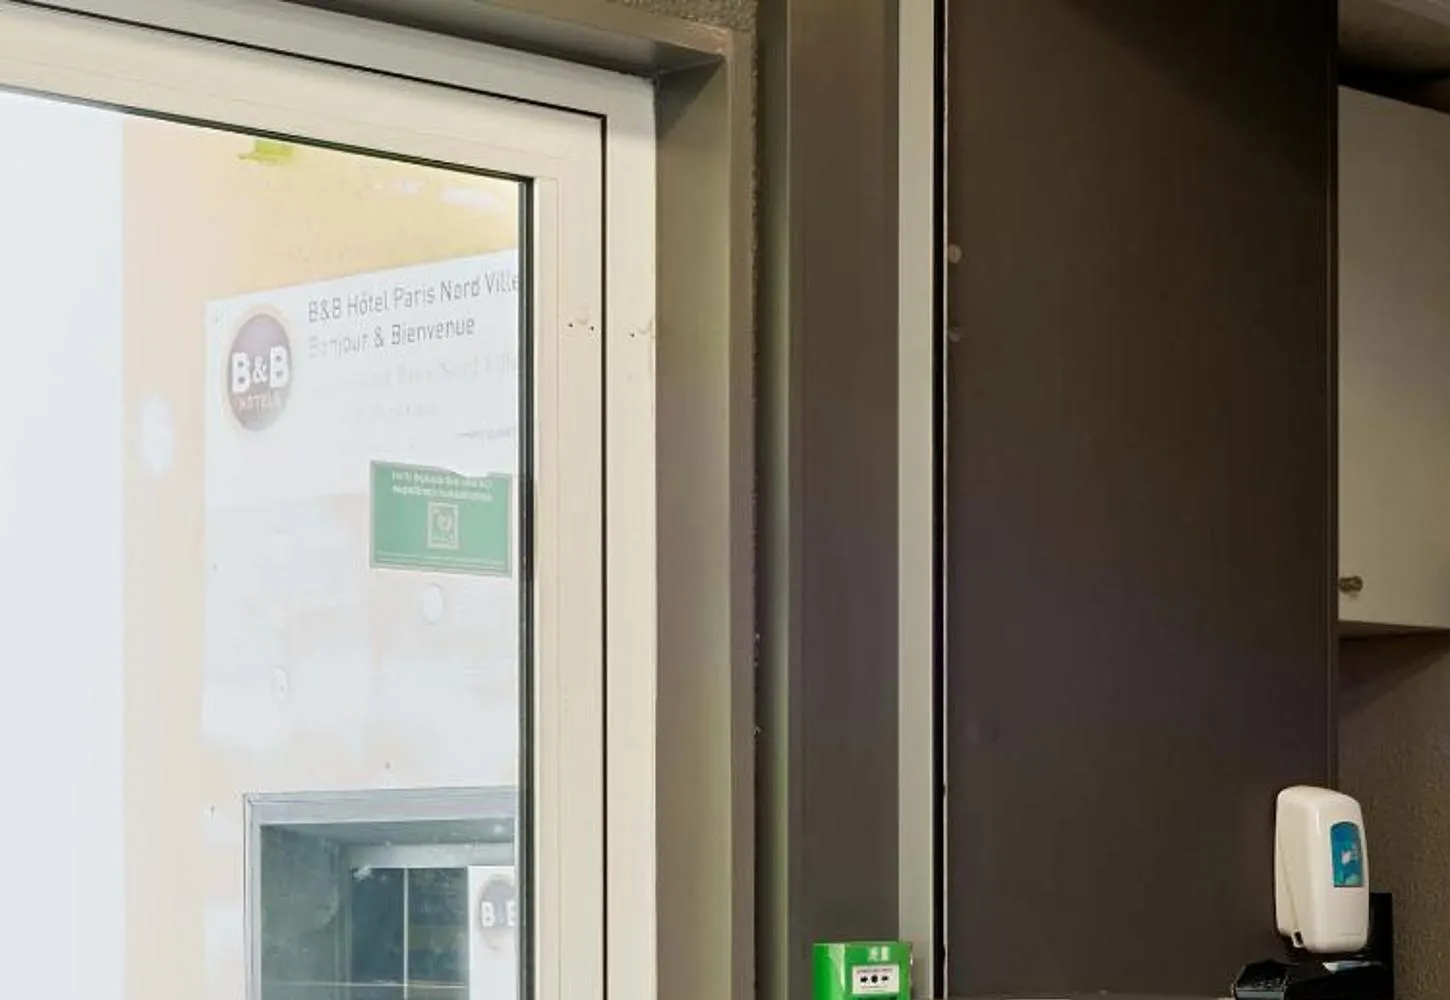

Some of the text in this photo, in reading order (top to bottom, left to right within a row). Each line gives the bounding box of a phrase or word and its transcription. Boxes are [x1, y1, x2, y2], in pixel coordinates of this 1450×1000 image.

[308, 296, 342, 323] B&B
[346, 290, 389, 318] Hôtel
[393, 285, 436, 310] Paris
[440, 277, 481, 302] Nord
[374, 325, 385, 349] &
[391, 315, 476, 347] Bienvenue
[232, 345, 290, 396] B&B
